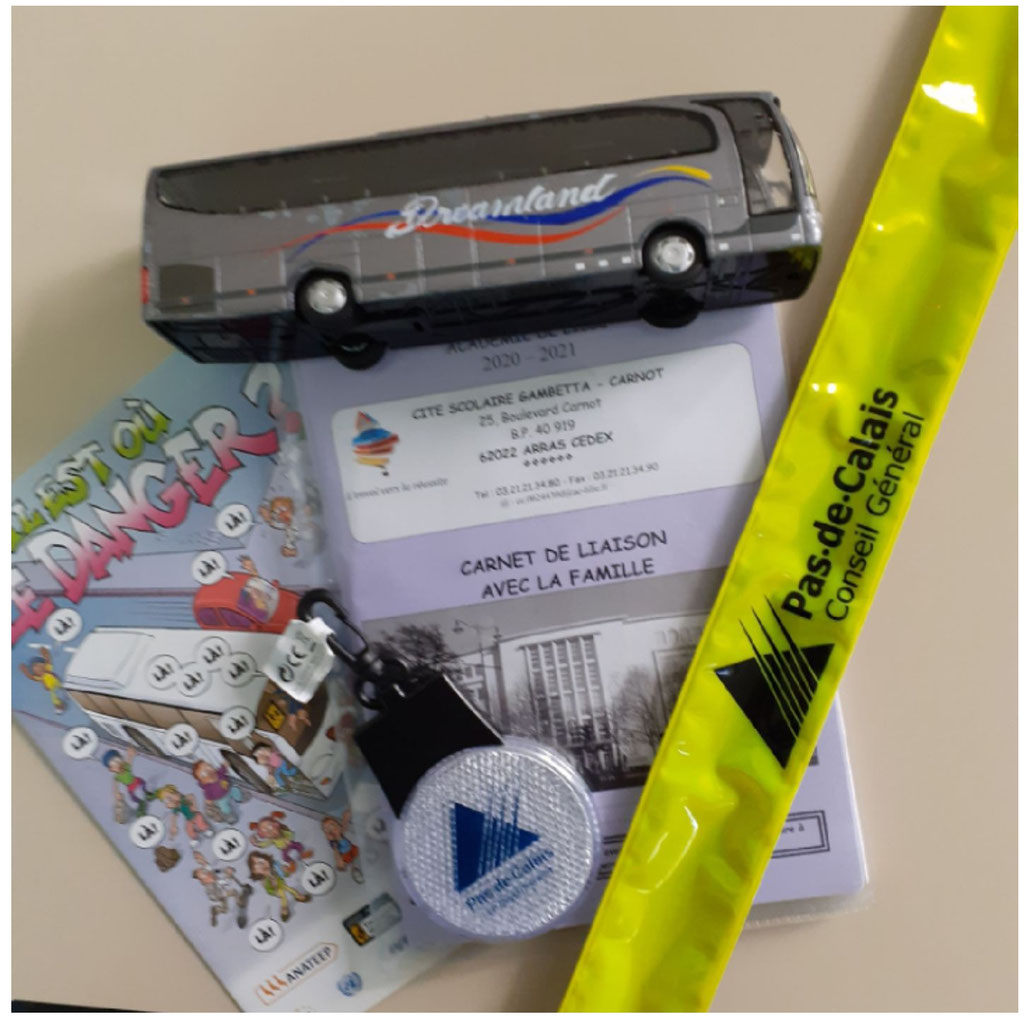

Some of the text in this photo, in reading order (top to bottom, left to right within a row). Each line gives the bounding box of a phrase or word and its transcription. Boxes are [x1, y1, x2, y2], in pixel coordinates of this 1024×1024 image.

[385, 173, 618, 240] Dreamland
[481, 351, 521, 372] 2020
[539, 342, 577, 363] 2021
[411, 404, 445, 421] CITE
[448, 392, 515, 415] SCOLAIRE
[518, 381, 592, 403] GAMBETTA
[608, 367, 665, 389] CARNOT
[501, 405, 559, 424] Boulevard
[478, 430, 615, 464] 62022 ARRAS CEDEX
[35, 439, 112, 522] EST
[25, 404, 281, 606] DANGER
[825, 410, 926, 622] Conseil Général
[460, 529, 668, 576] CARNET DE LIAISON
[481, 558, 656, 600] AVEC LA FAMILLE
[285, 945, 333, 984] ANATEEP
